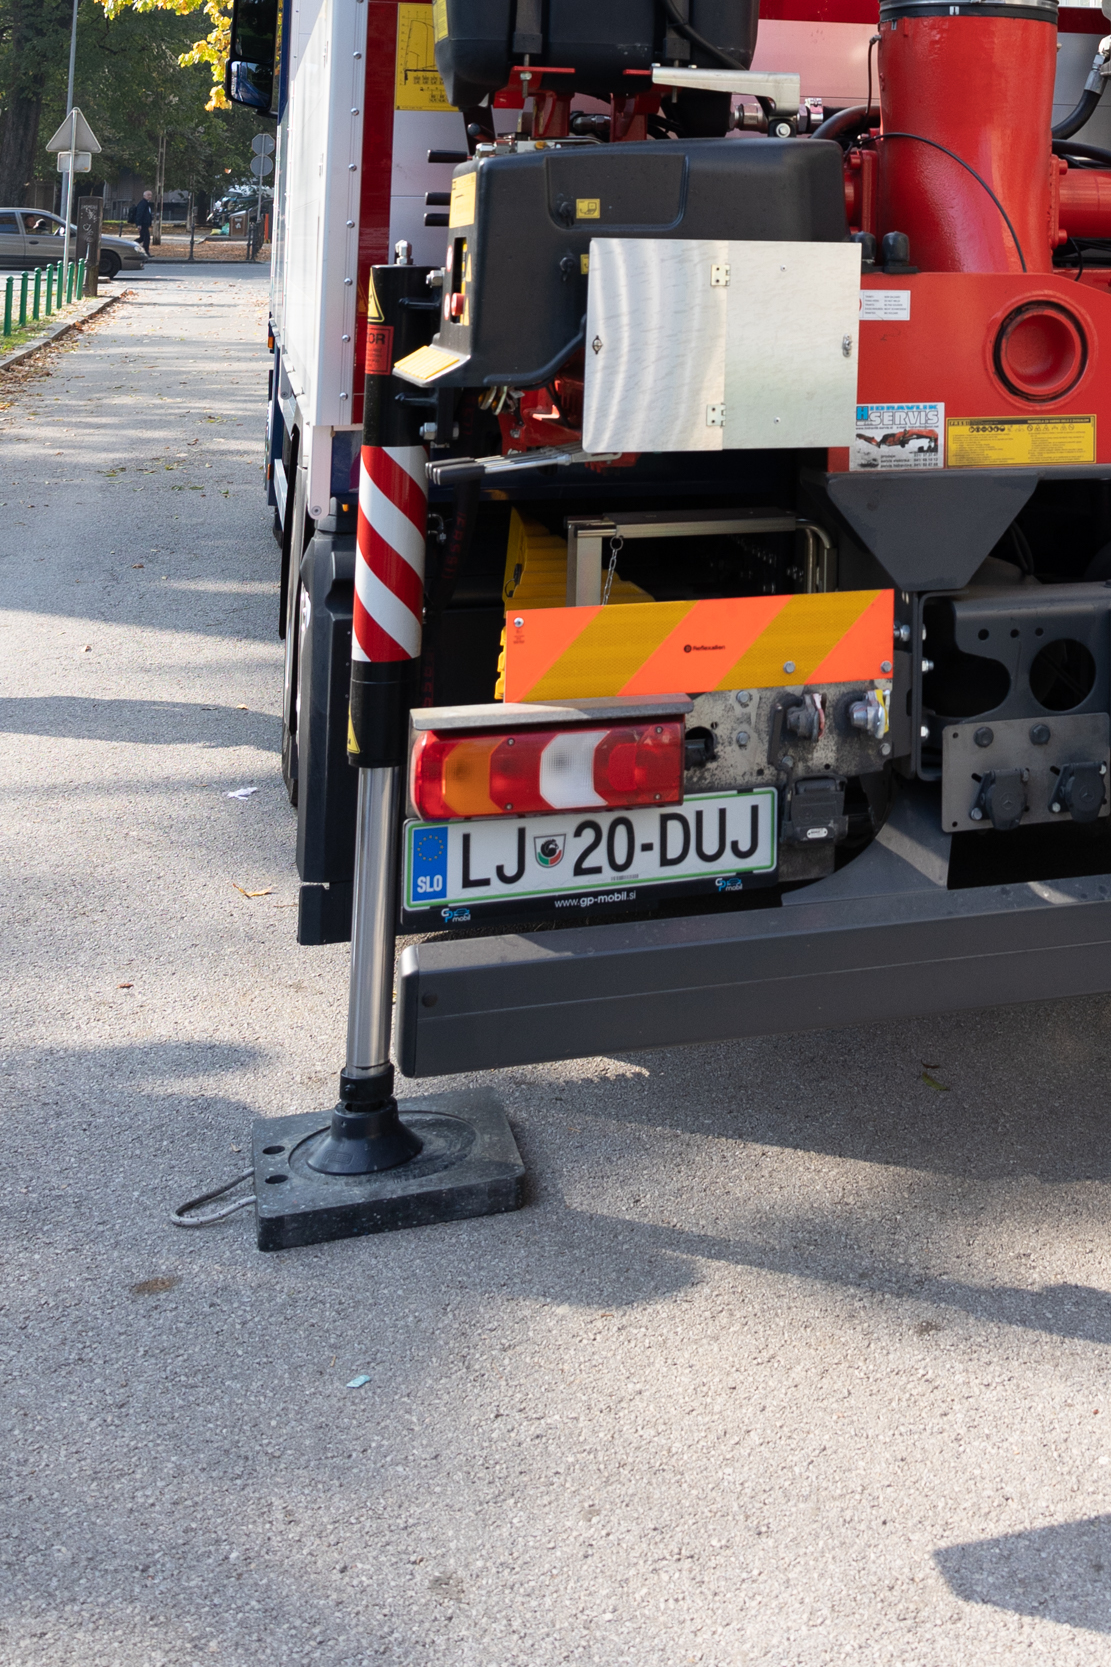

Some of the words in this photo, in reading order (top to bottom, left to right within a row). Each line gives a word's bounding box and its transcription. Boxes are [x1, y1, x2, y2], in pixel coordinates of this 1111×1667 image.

[366, 332, 386, 345] OR
[855, 404, 938, 421] HIDRAVLIK
[868, 410, 939, 426] SERVIS
[461, 826, 526, 889] LJ
[572, 804, 759, 877] 20-DUJ
[416, 874, 443, 894] SLO
[725, 881, 743, 892] mobil
[554, 890, 637, 908] www.gp-mobil.si
[452, 911, 471, 923] mobil
